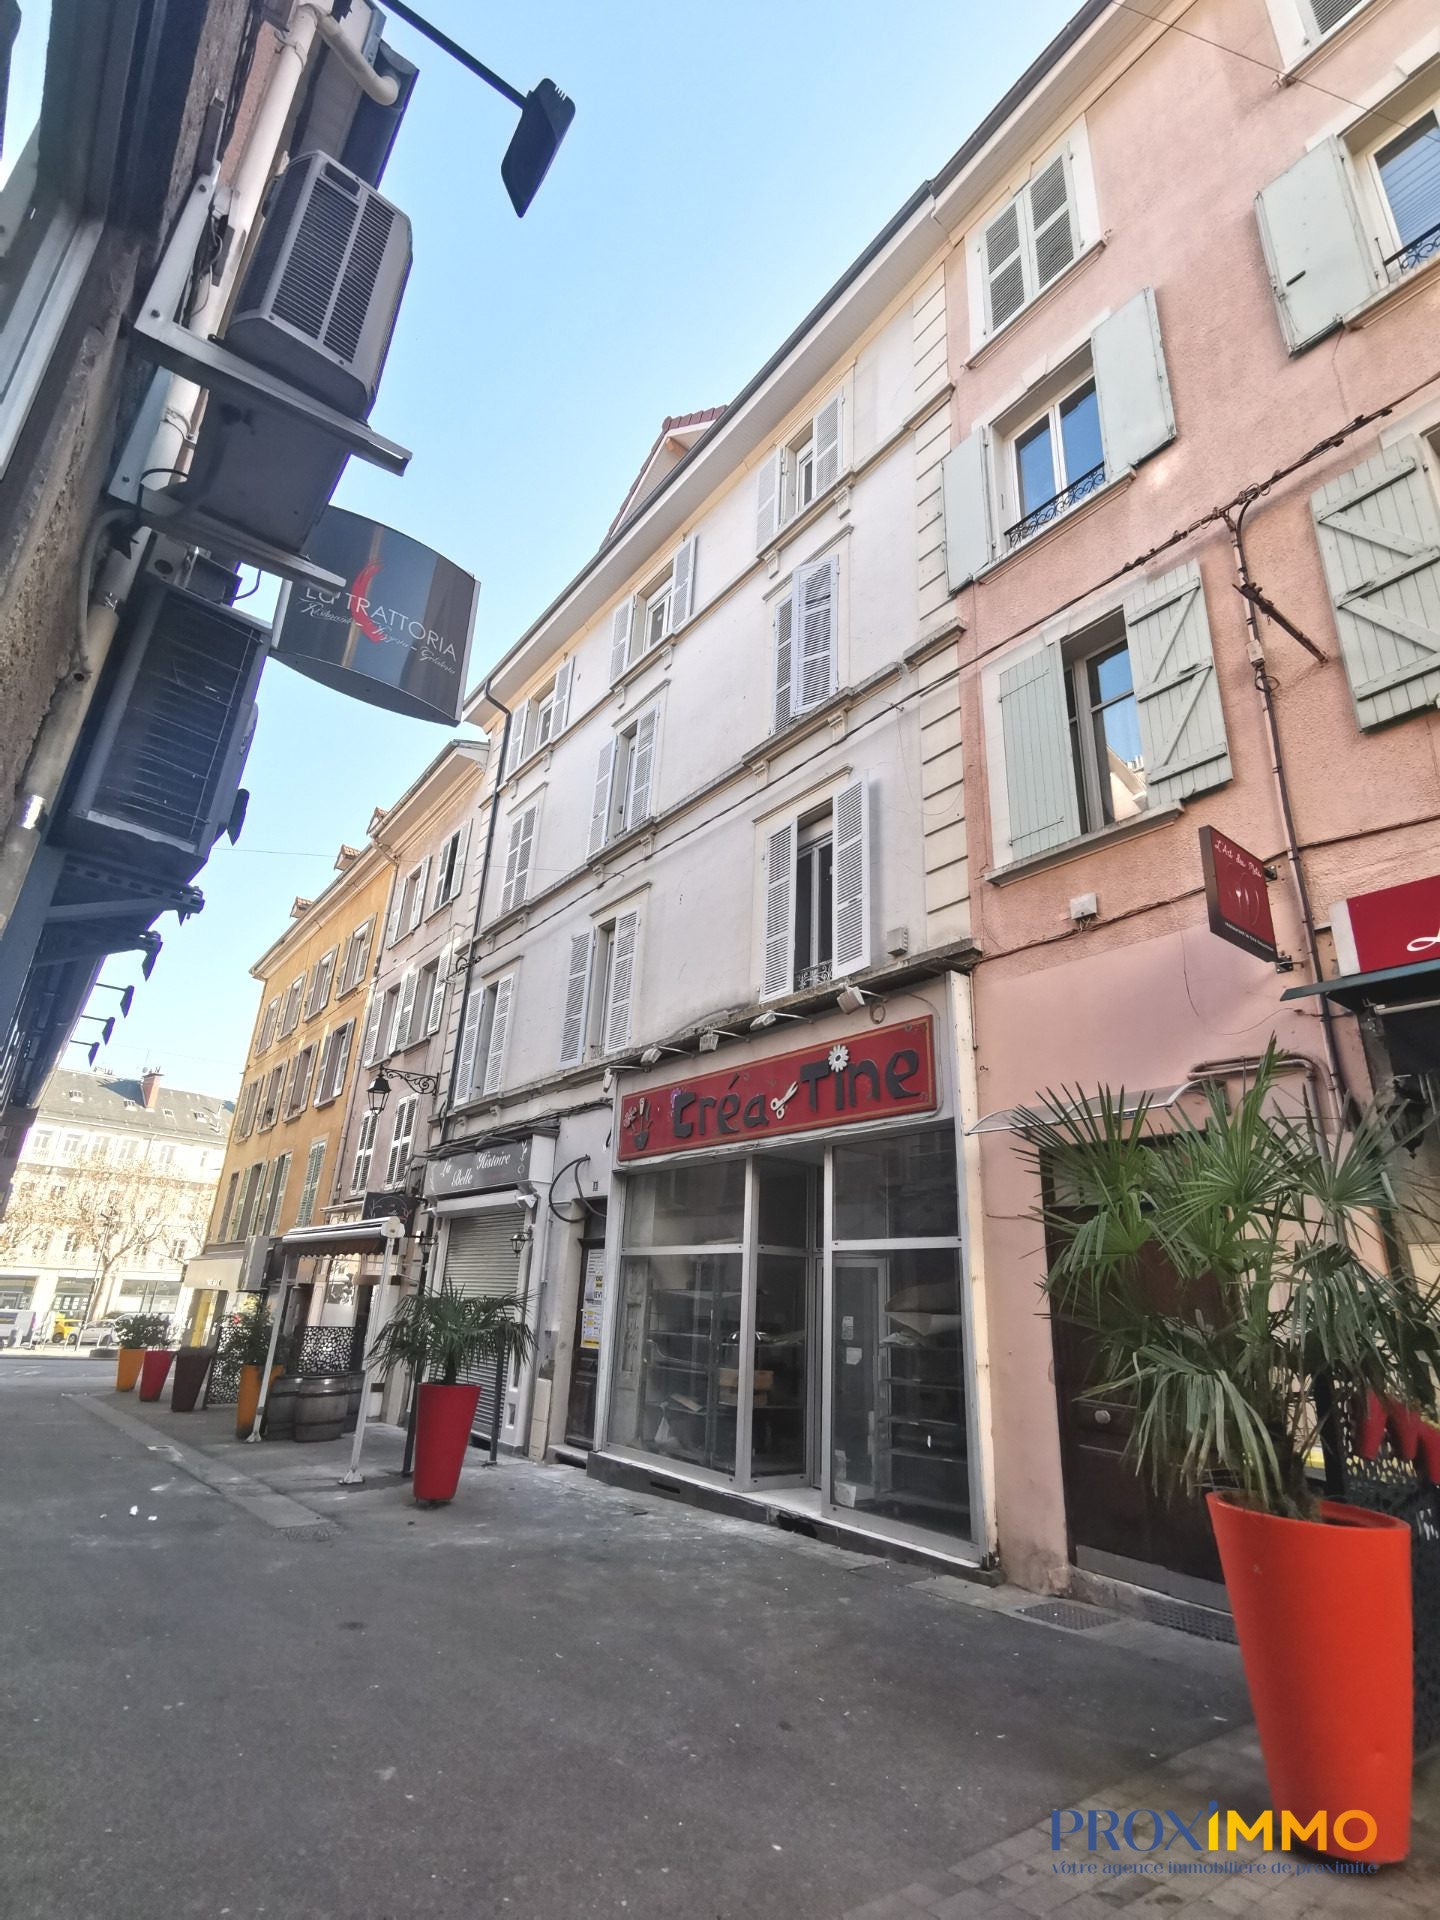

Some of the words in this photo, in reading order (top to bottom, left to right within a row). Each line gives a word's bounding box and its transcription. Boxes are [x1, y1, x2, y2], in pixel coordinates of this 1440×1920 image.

[345, 592, 457, 662] TRATTORIA
[672, 1071, 770, 1138] Créa
[800, 1045, 921, 1112] Tine
[440, 1158, 452, 1177] La
[451, 1167, 473, 1187] Belle
[476, 1151, 512, 1170] Histoire
